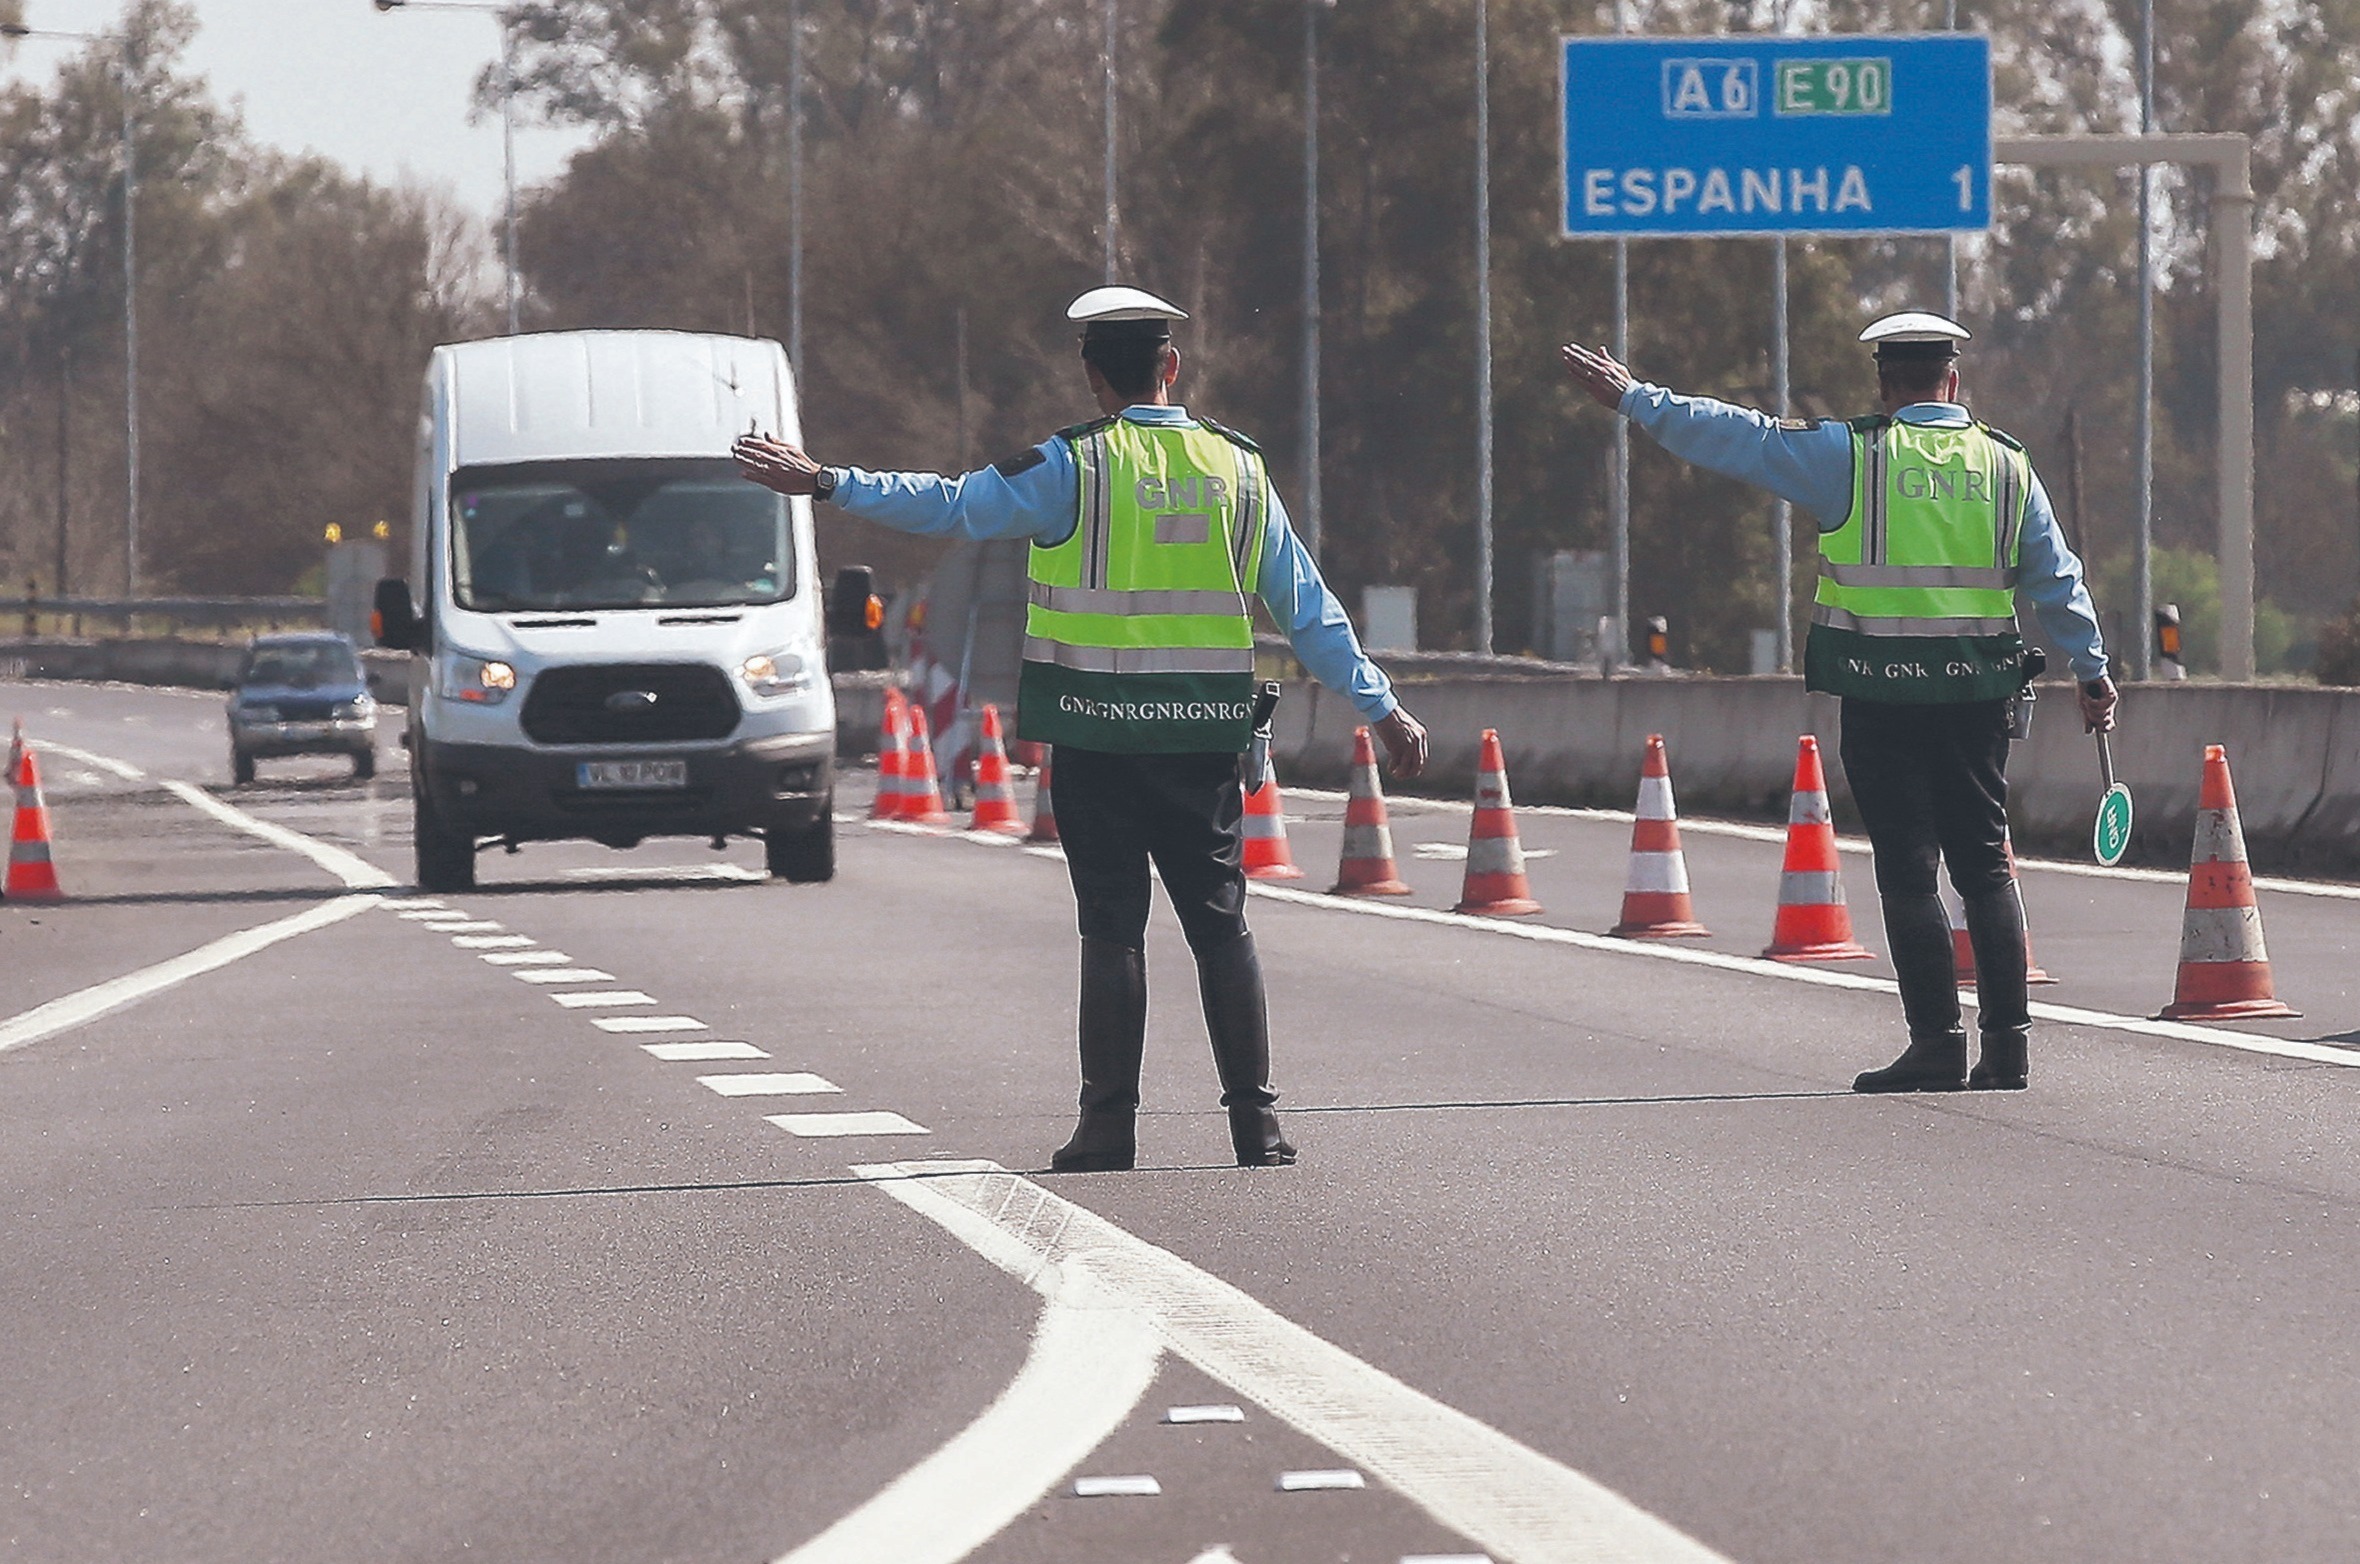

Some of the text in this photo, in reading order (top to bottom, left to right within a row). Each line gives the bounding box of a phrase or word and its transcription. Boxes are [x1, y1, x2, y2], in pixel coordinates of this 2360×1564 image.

[1584, 163, 1974, 216] ESPANHA 1
[1134, 475, 1228, 510] GNR
[1896, 466, 1991, 504] GNR
